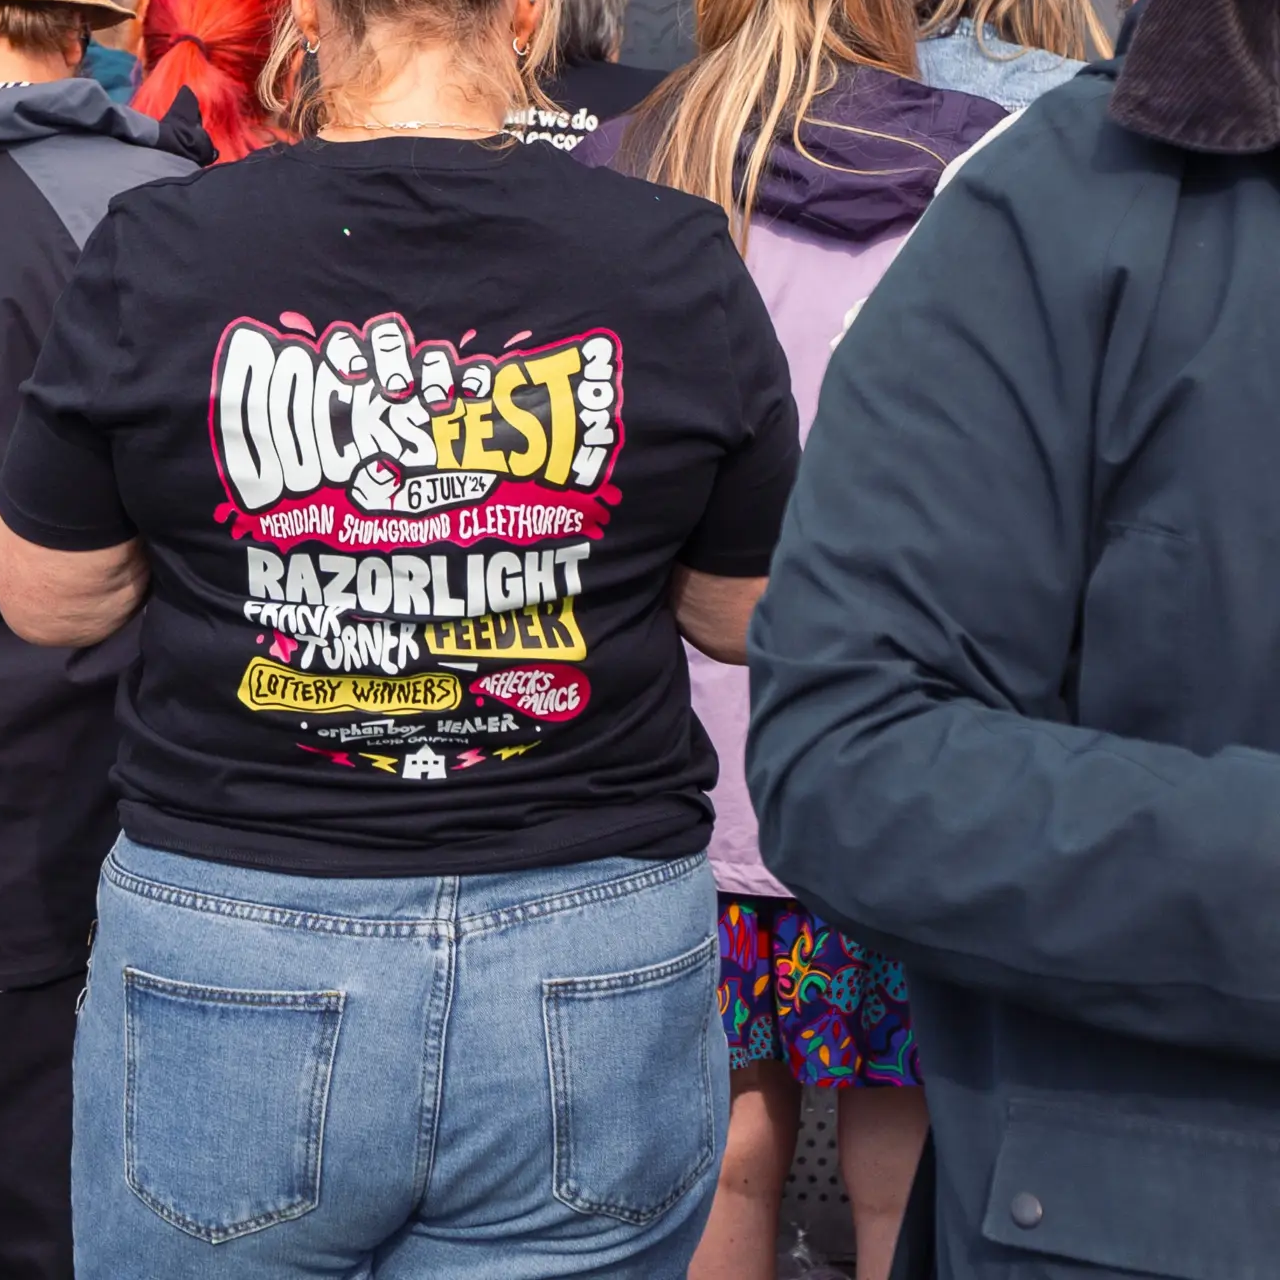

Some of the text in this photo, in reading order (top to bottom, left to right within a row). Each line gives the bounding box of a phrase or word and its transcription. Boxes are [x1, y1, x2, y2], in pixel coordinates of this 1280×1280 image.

[571, 108, 598, 132] do
[572, 337, 614, 487] 2024
[407, 480, 422, 510] 6
[426, 475, 468, 504] JULY
[260, 503, 584, 545] MERIDIAN SHOWGROUND CLEETHORPES
[247, 542, 590, 617] RAZORLIGHT
[243, 600, 352, 638] FRANK
[435, 602, 570, 650] FEEDER
[294, 622, 419, 675] TURNER
[254, 669, 342, 706] LOTTERY
[479, 669, 555, 697] AFFLECKS
[517, 682, 581, 716] PALACE
[317, 719, 426, 743] orphan boy
[437, 713, 520, 734] HEALER
